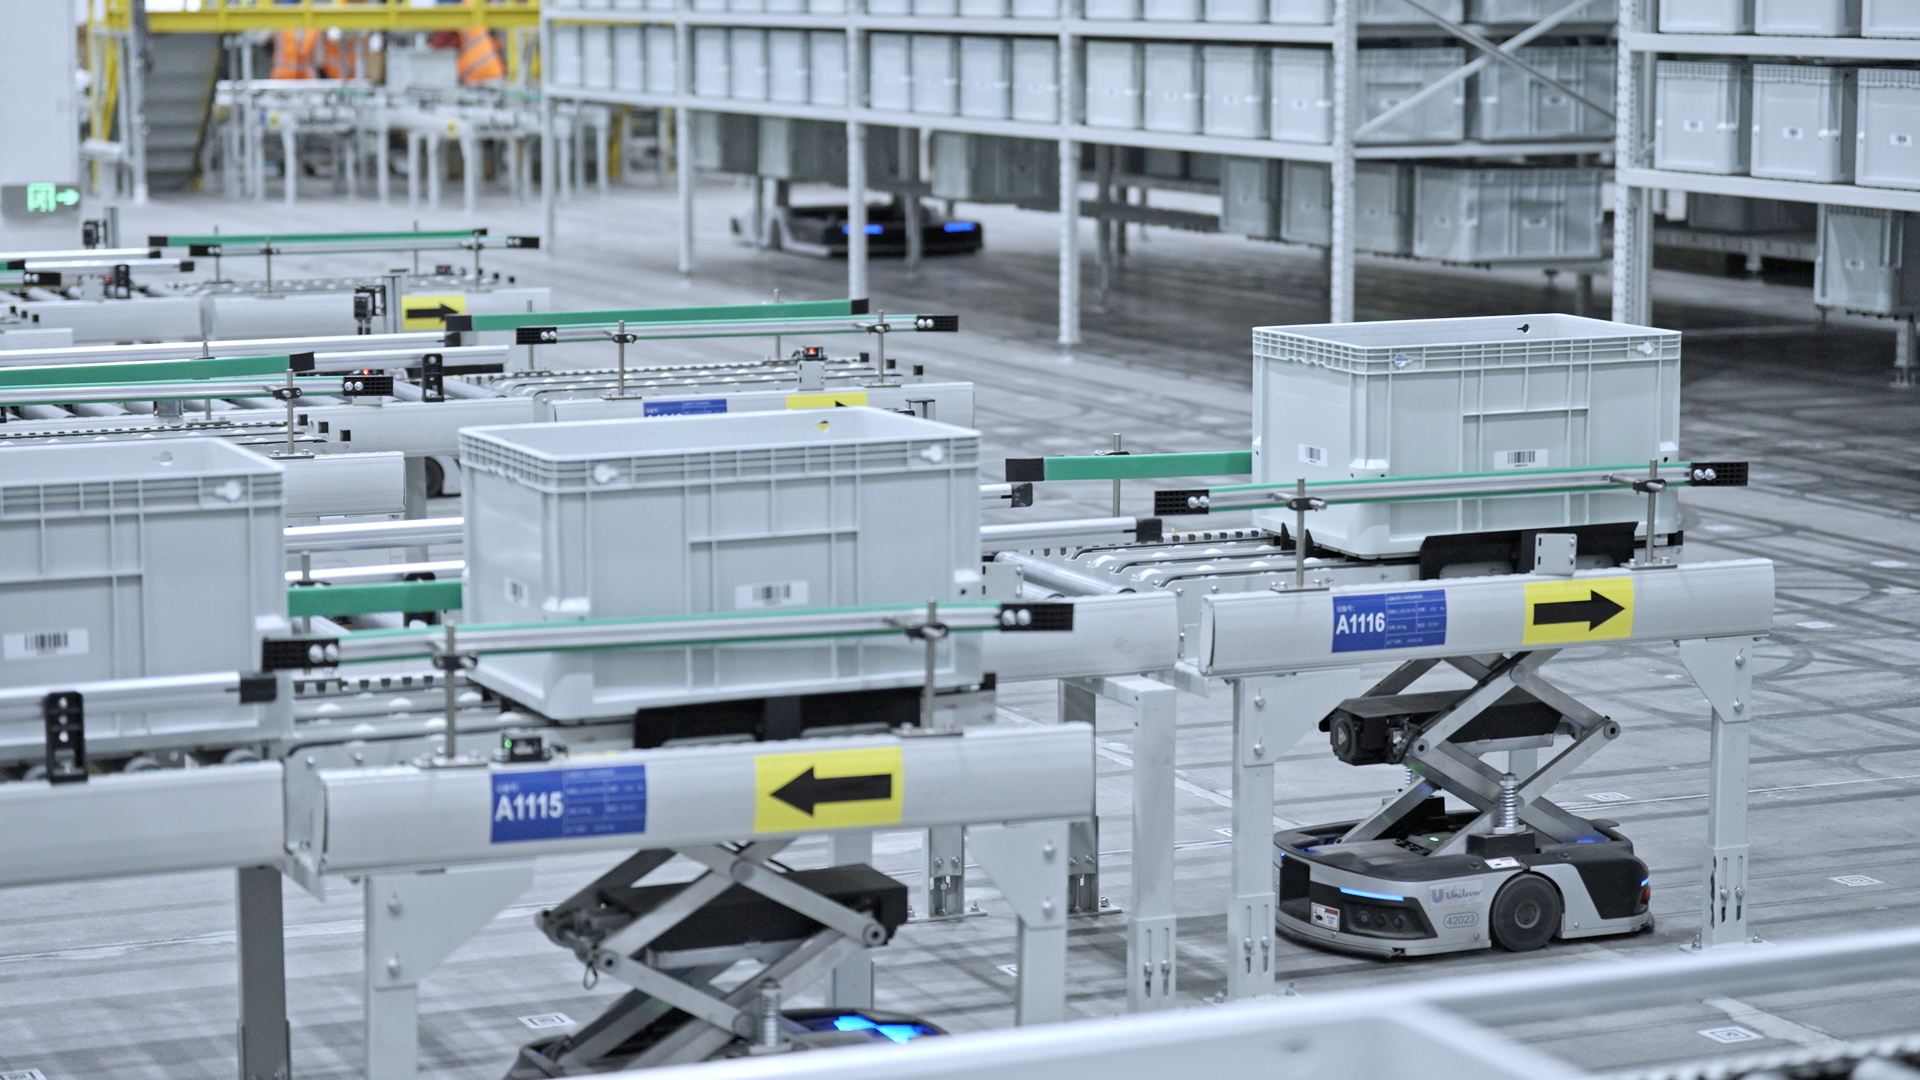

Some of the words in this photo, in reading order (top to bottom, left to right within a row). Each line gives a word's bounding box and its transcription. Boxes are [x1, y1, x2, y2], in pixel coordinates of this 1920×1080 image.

[1335, 612, 1386, 635] A1116
[494, 790, 565, 823] A1115
[1446, 888, 1482, 900] Unilever
[1446, 914, 1476, 926] 42023
